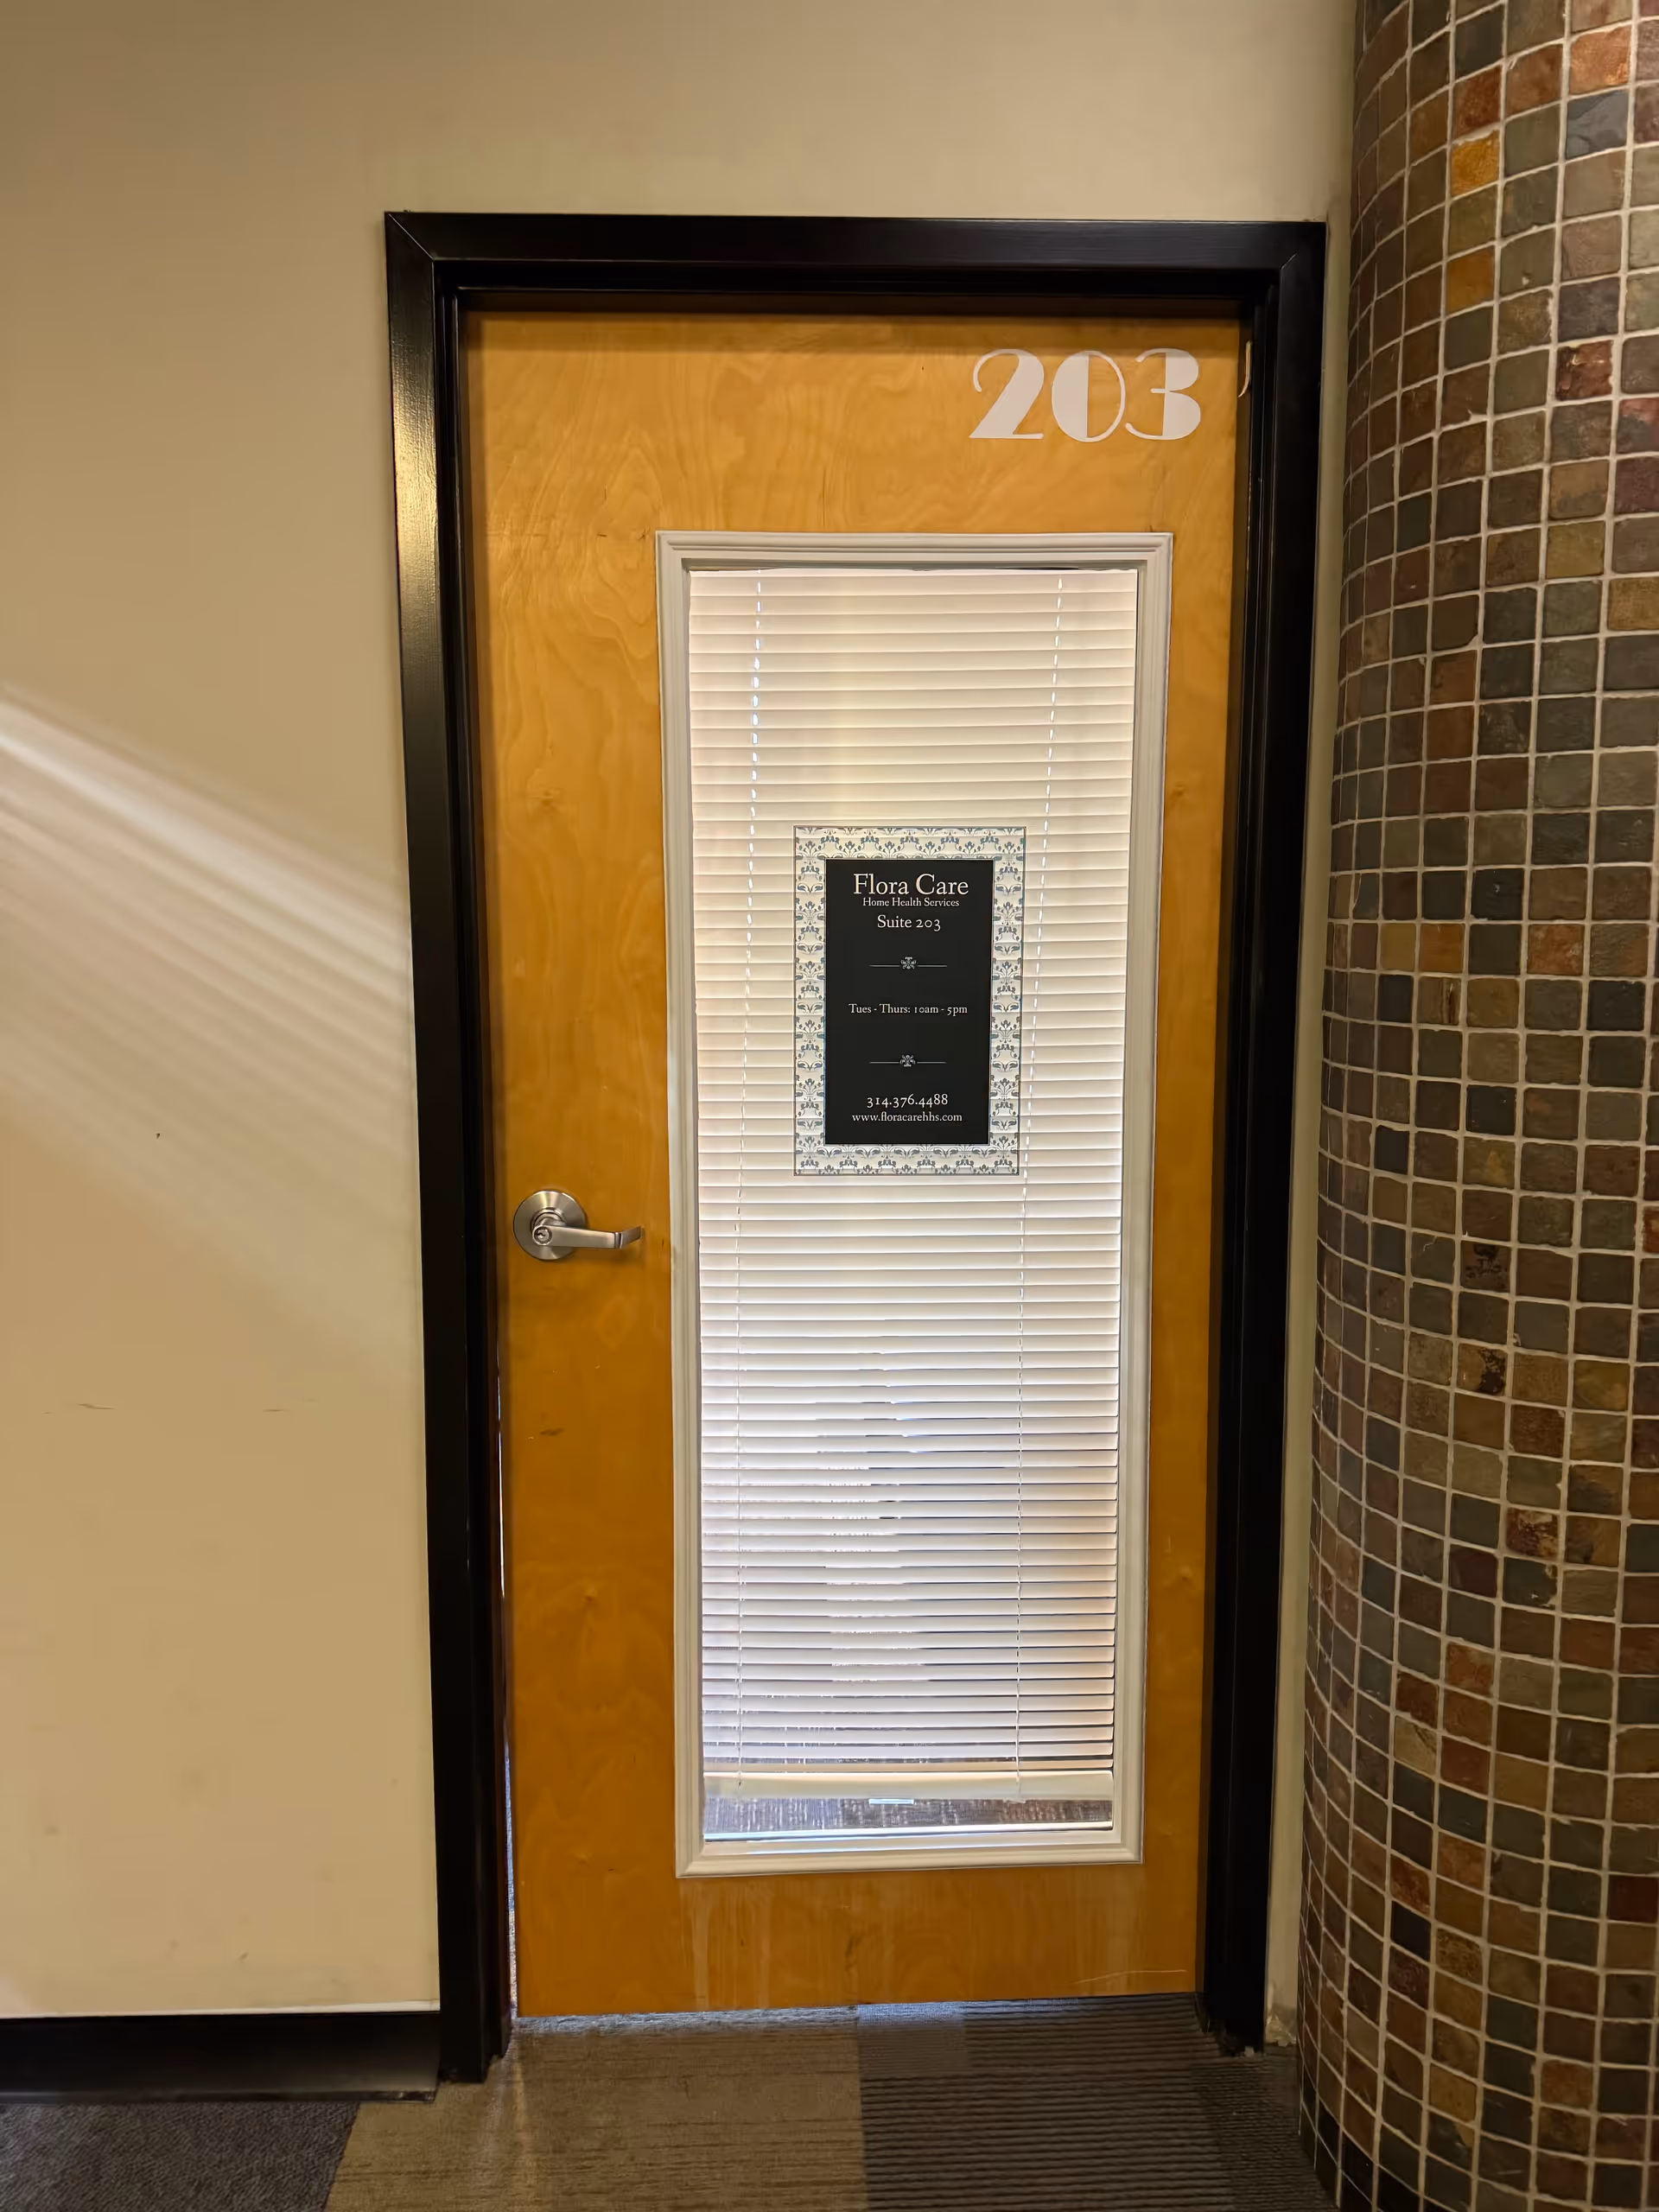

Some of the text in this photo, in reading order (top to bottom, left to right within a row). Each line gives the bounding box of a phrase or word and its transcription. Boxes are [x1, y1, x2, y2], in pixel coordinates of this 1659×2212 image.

[969, 347, 1201, 442] 203
[853, 873, 969, 895] Flora Care
[862, 897, 960, 906] Home Health Services
[877, 914, 941, 931] Suite 203
[848, 1003, 872, 1014] Tues
[879, 1003, 911, 1014] Thurs:
[947, 1007, 968, 1016] 5pm
[867, 1093, 949, 1108] 314.376.4488
[852, 1111, 963, 1122] www.floracarehhs.com
